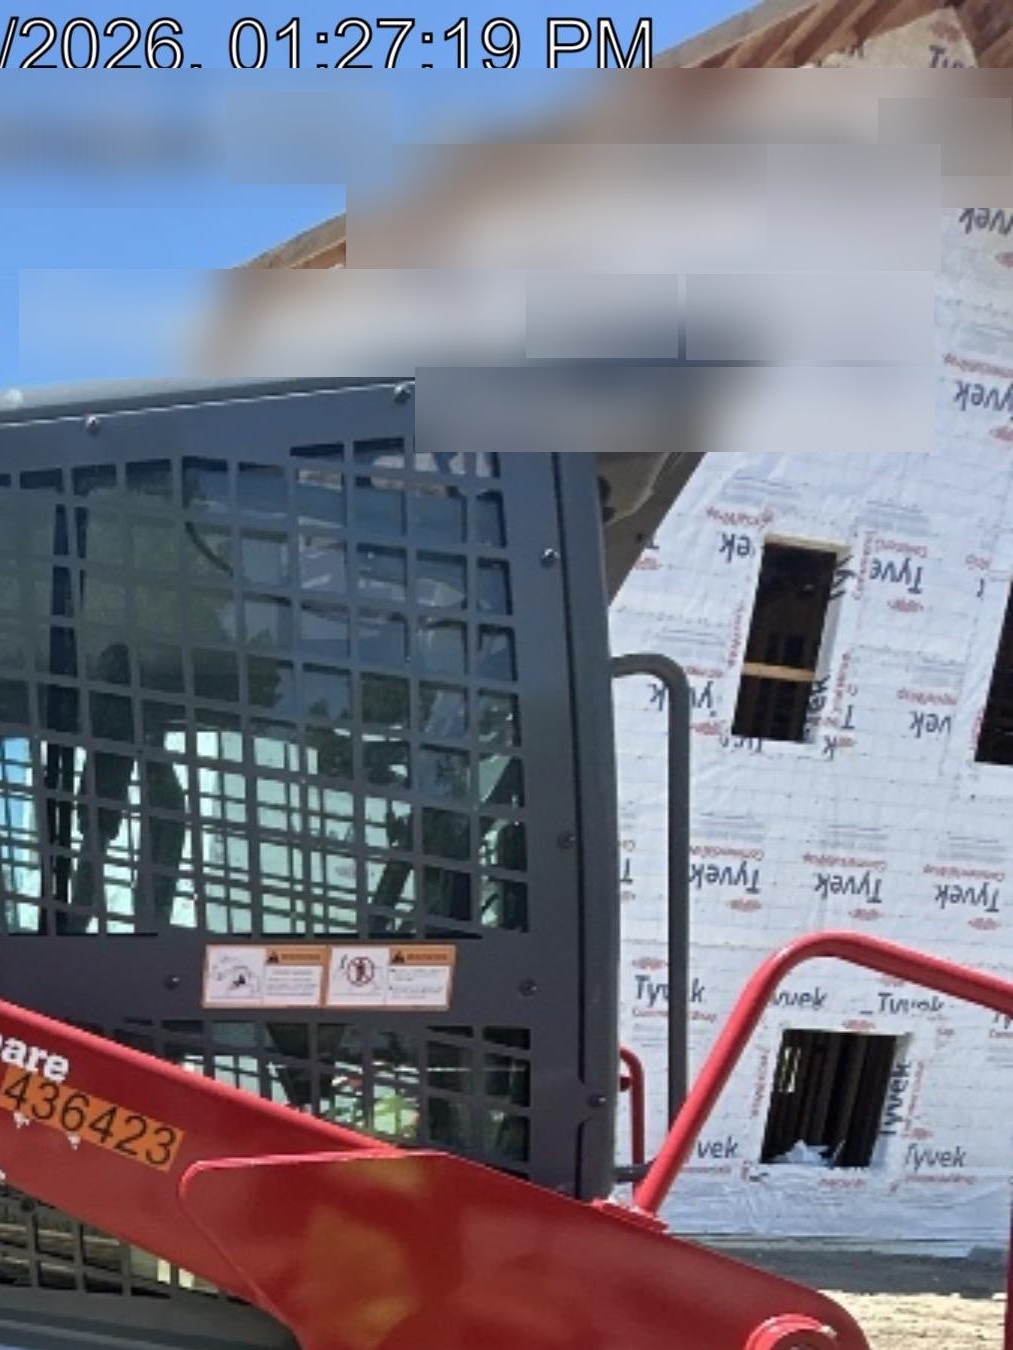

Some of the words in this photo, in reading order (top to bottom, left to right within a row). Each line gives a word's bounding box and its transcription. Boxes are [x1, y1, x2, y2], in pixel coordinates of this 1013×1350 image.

[688, 860, 760, 894] Tyvek
[814, 872, 882, 903] Tyvek
[936, 882, 1000, 912] Tyvek
[1, 1071, 178, 1166] 436423
[904, 1144, 967, 1171] Tyvek
